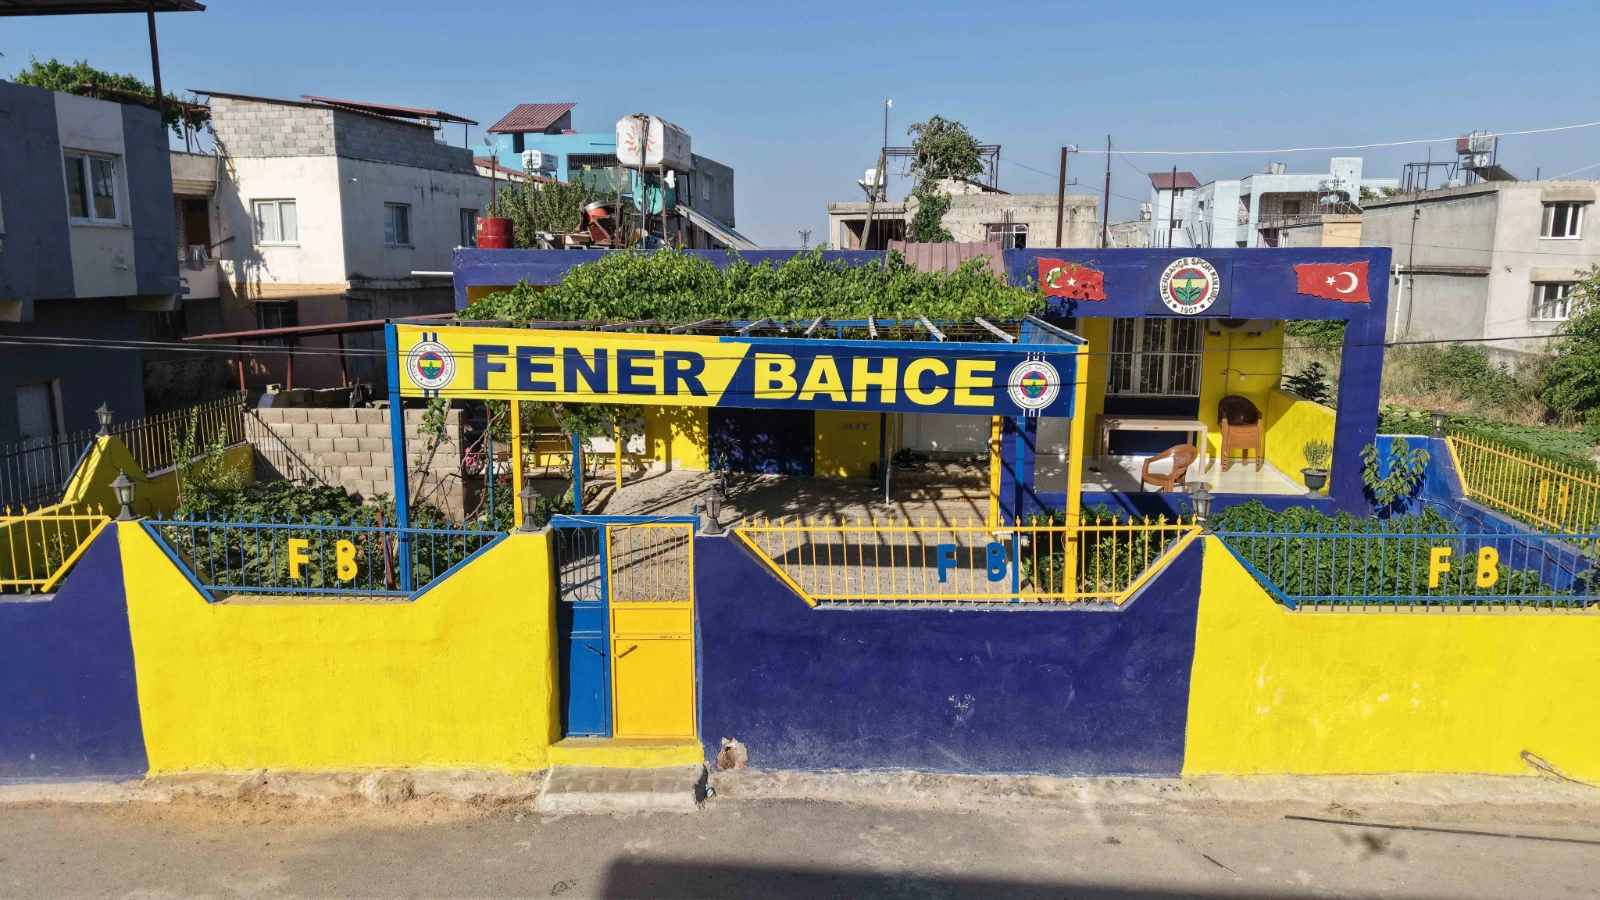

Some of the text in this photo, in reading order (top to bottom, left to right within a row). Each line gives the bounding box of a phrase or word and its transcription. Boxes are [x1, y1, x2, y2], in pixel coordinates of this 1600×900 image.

[1162, 258, 1189, 304] FENERBAHÇE
[1191, 258, 1213, 272] SPOR
[474, 344, 996, 407] FENER BAHCE
